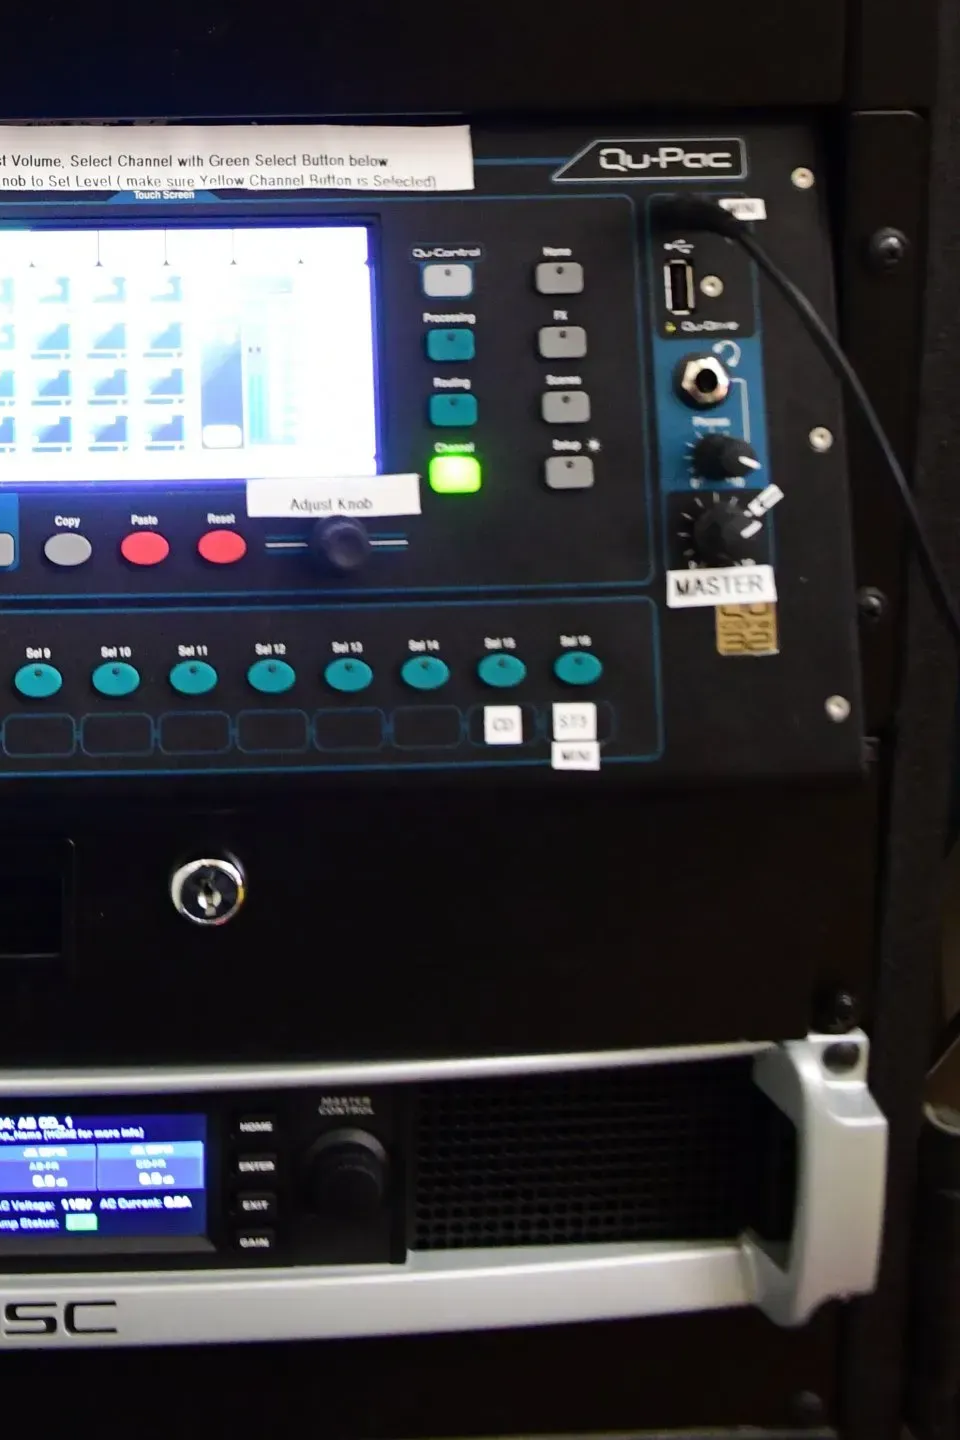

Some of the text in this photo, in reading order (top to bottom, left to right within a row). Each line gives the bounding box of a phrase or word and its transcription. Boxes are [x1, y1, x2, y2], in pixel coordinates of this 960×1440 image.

[11, 155, 64, 169] Volume,
[70, 155, 112, 168] Select
[117, 155, 172, 168] Channel
[177, 154, 204, 167] with
[208, 154, 250, 167] Green
[254, 154, 297, 167] Select
[302, 154, 344, 167] Button
[349, 154, 388, 167] below
[599, 146, 732, 171] Qu-Pac
[31, 175, 44, 188] to
[48, 175, 70, 188] Set
[75, 175, 112, 188] Level
[126, 176, 162, 190] make
[166, 178, 195, 188] sure
[199, 175, 245, 187] Yellow
[249, 174, 304, 187] Channel
[309, 174, 352, 187] Button
[134, 190, 195, 200] Touch Screen
[290, 498, 373, 513] Adjust Knob
[54, 515, 81, 529] Copy
[130, 513, 159, 526] Paste
[207, 512, 236, 524] Reset
[673, 574, 764, 597] MASTER
